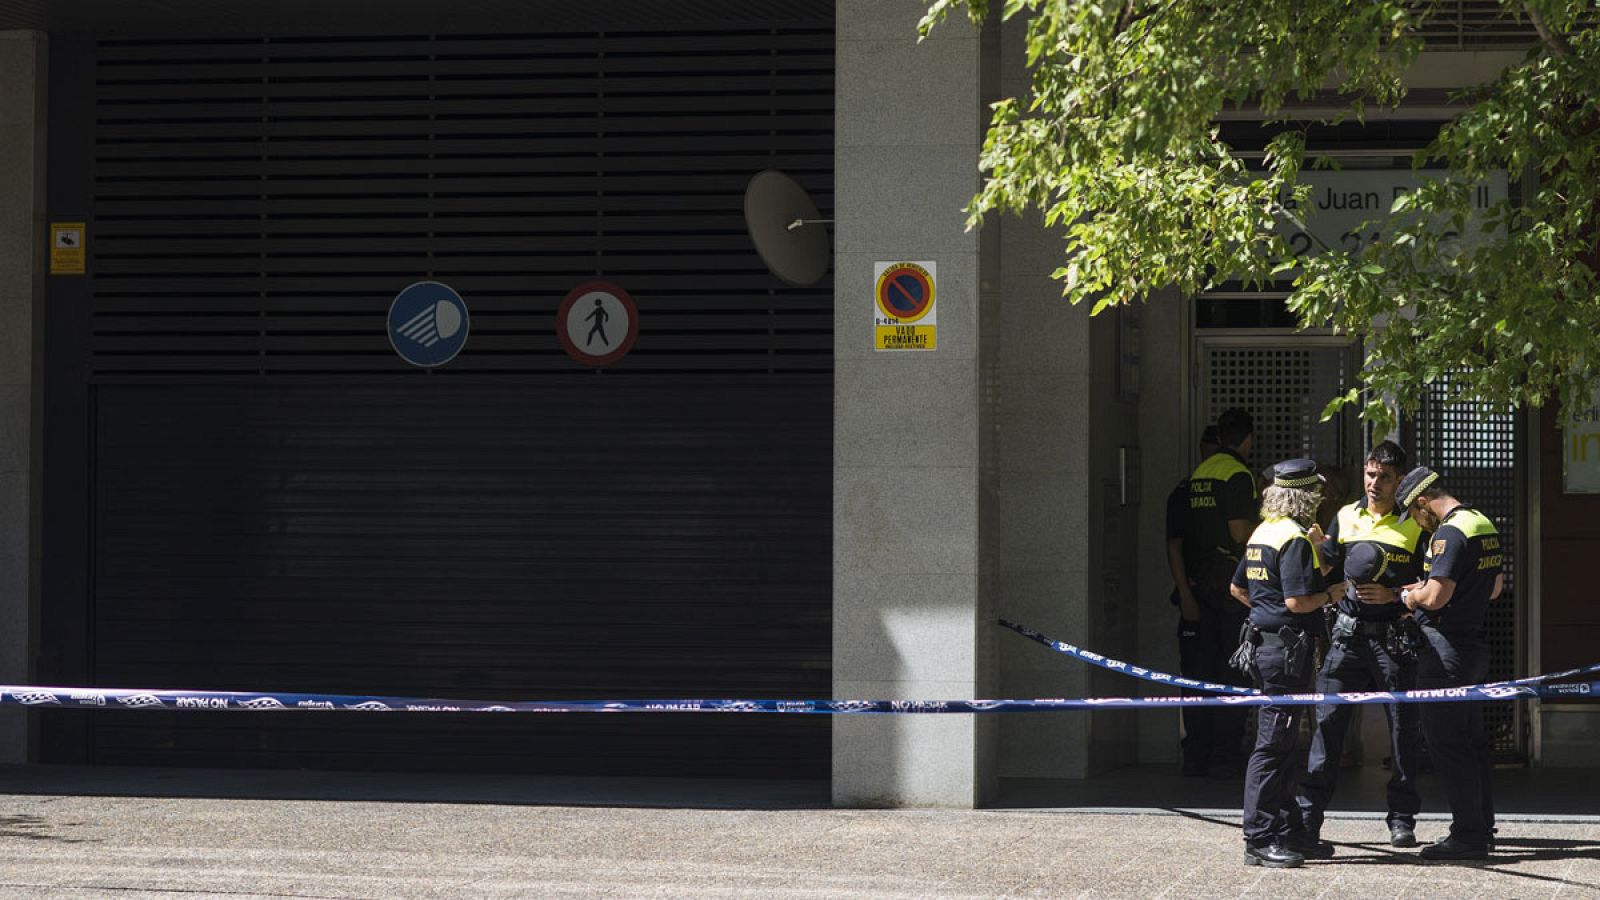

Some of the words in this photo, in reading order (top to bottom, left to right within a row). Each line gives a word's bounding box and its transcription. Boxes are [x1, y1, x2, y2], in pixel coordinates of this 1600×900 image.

[1318, 186, 1380, 210] Juan
[895, 325, 916, 335] VADO
[883, 334, 928, 344] PERMANENTE
[1385, 552, 1410, 564] OLICIA
[1405, 688, 1445, 697] PASAR
[1446, 687, 1467, 697] NO
[175, 697, 209, 708] PASAR
[211, 698, 229, 708] NO
